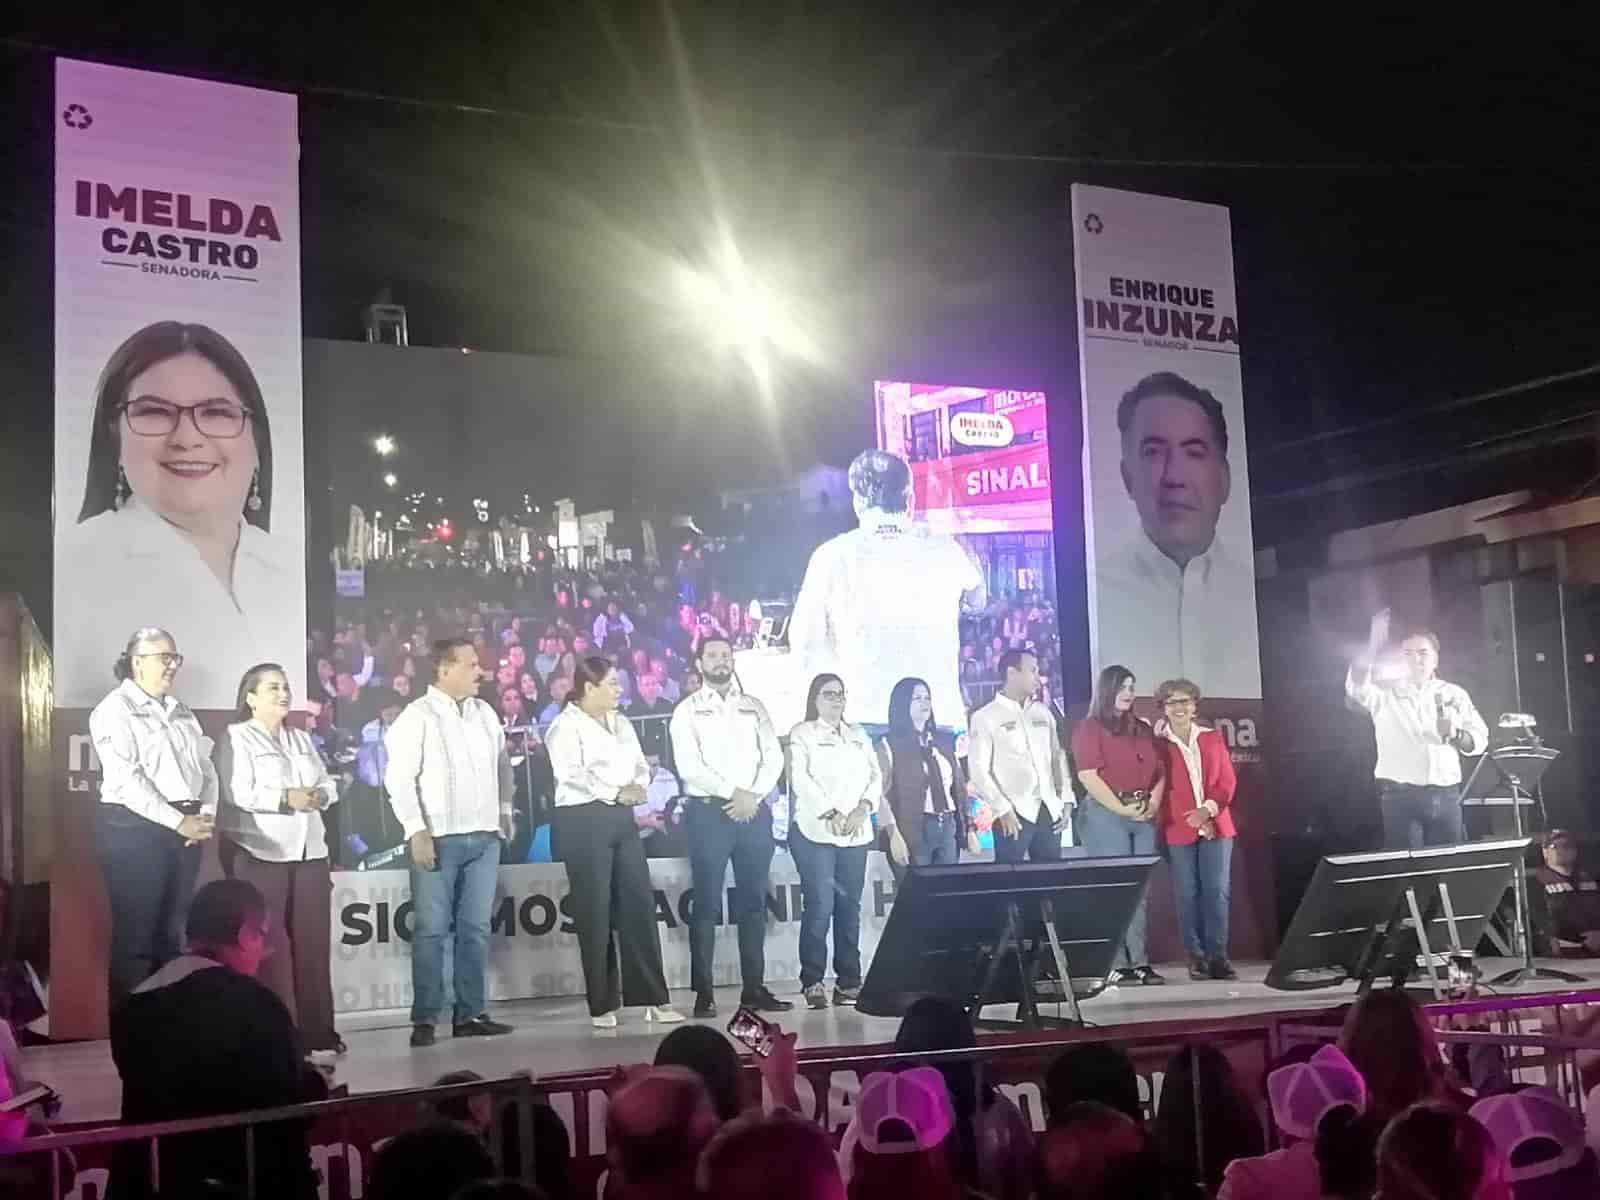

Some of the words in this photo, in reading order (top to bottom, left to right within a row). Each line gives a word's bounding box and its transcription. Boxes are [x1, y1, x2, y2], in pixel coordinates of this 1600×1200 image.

[75, 180, 281, 242] IMELDA
[102, 227, 258, 270] CASTRO
[141, 263, 221, 281] SENADORA
[1110, 276, 1215, 309] ENRIQUE
[1083, 298, 1239, 345] INZUNZA
[967, 463, 1049, 496] SINAL
